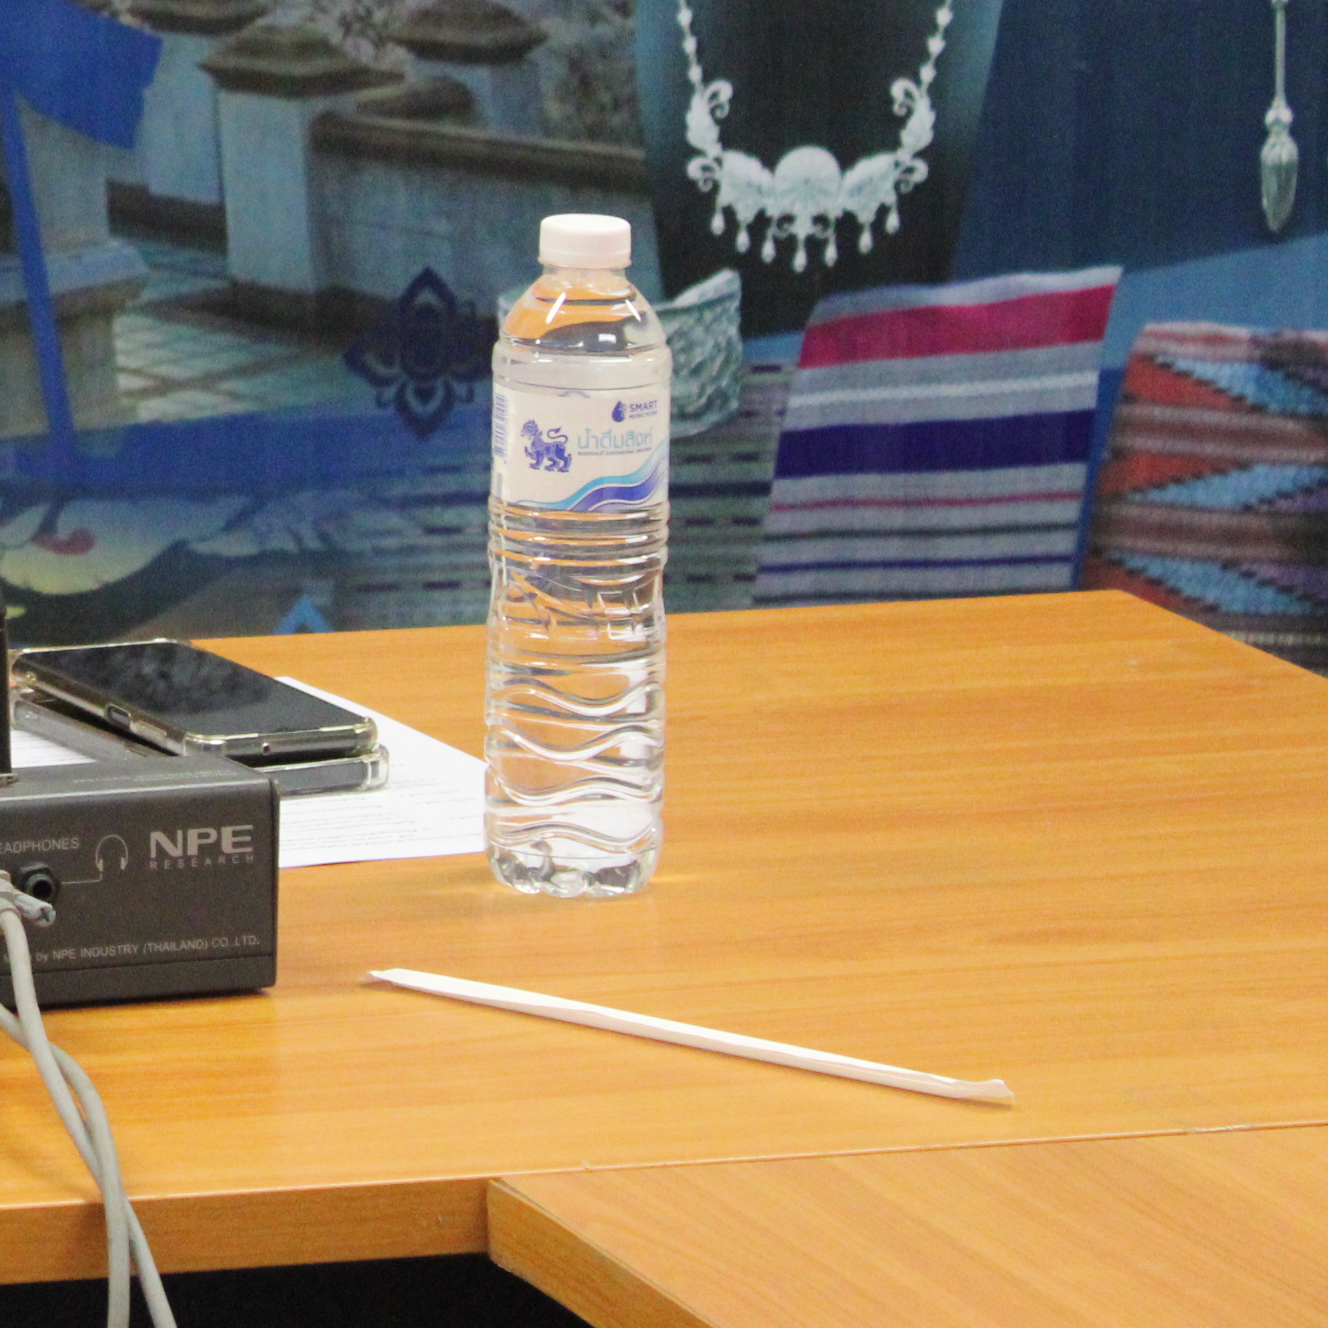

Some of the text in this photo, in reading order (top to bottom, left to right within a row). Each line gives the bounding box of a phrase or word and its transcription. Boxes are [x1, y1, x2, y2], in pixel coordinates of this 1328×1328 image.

[629, 400, 658, 413] SMART
[149, 825, 253, 859] NPE
[149, 854, 254, 871] RESEARCH
[52, 948, 76, 960] NPE
[80, 943, 139, 959] INDUSTRY
[143, 939, 209, 955] (THAILAND)
